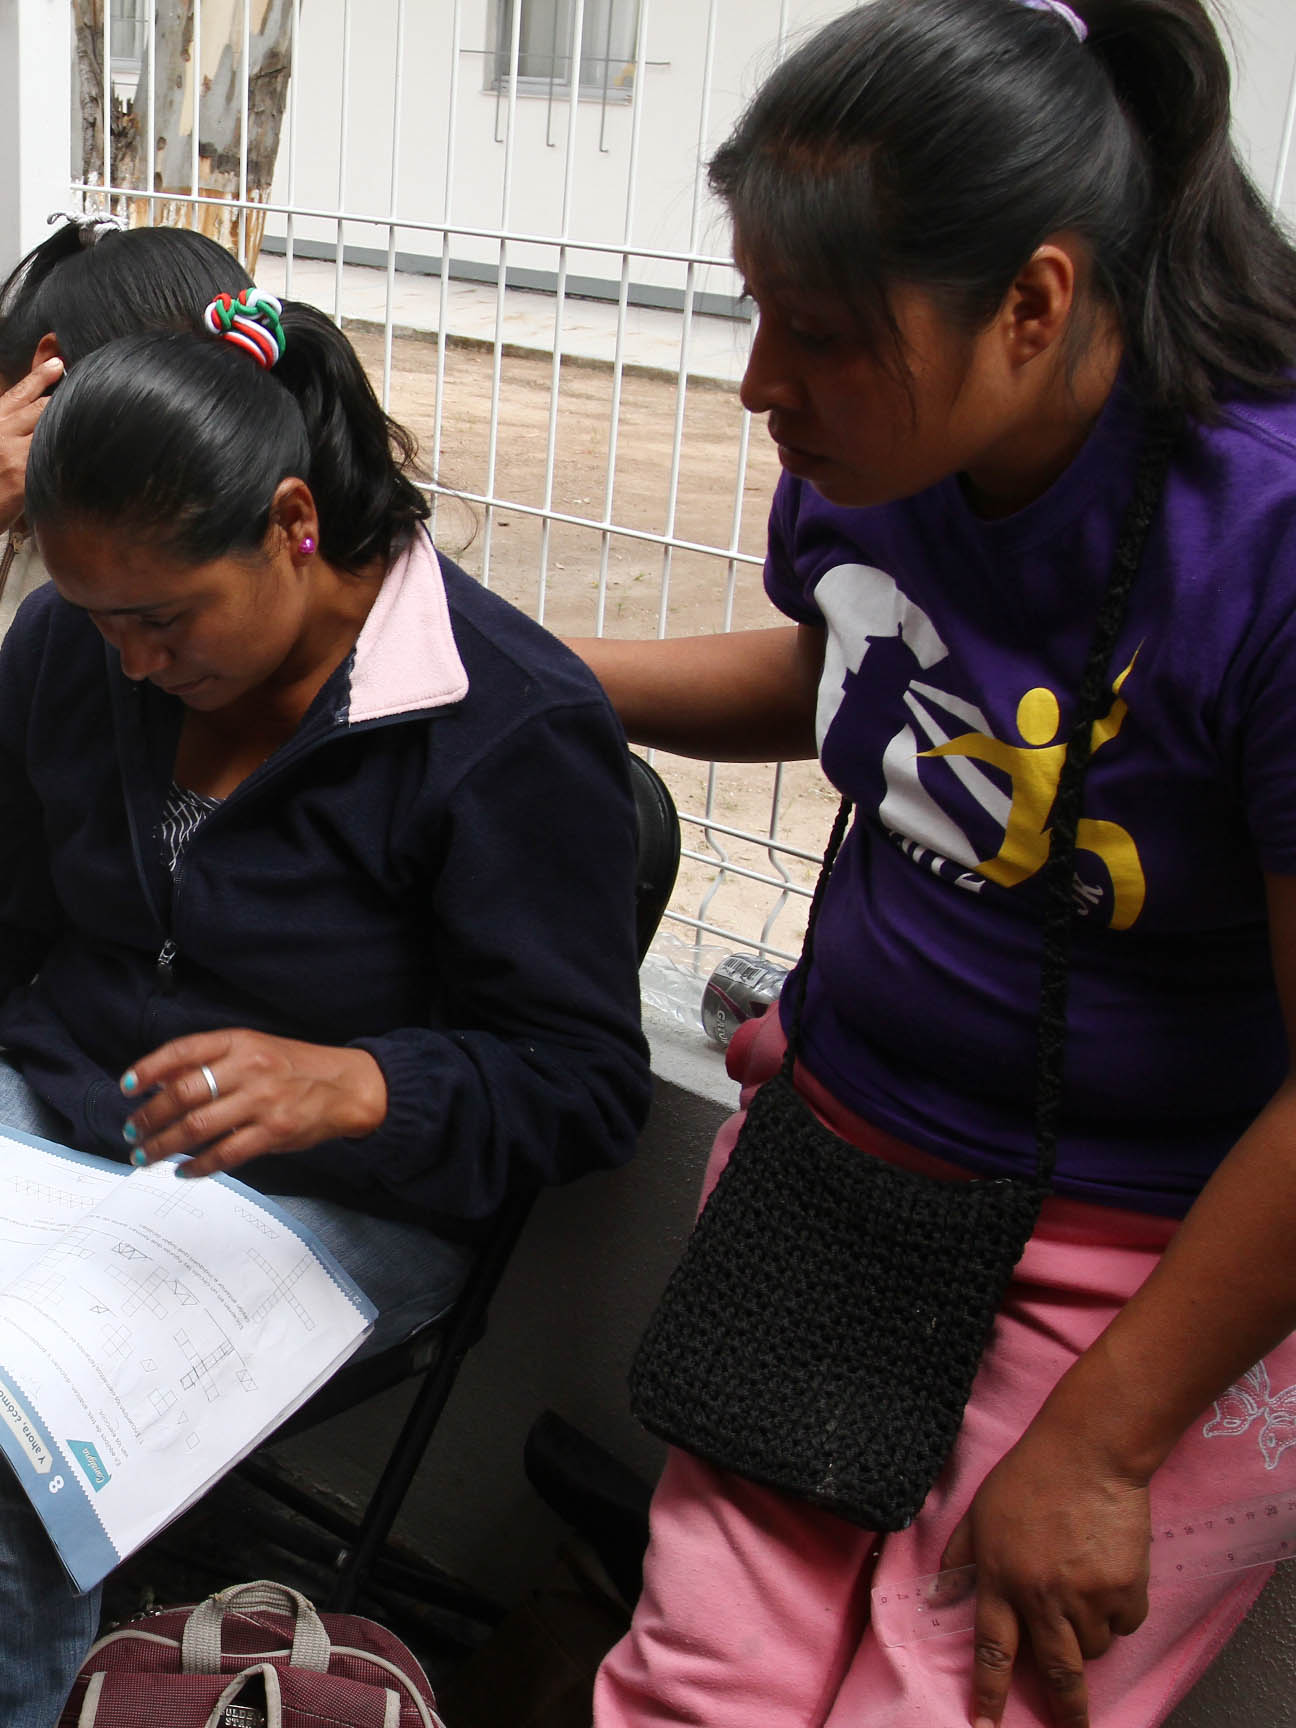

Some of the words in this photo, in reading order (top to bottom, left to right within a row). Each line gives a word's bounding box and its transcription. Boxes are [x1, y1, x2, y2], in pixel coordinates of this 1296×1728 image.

[22, 1422, 42, 1454] ahora,
[37, 1456, 46, 1464] Y
[82, 1447, 104, 1484] Consigna
[48, 1475, 64, 1494] 8
